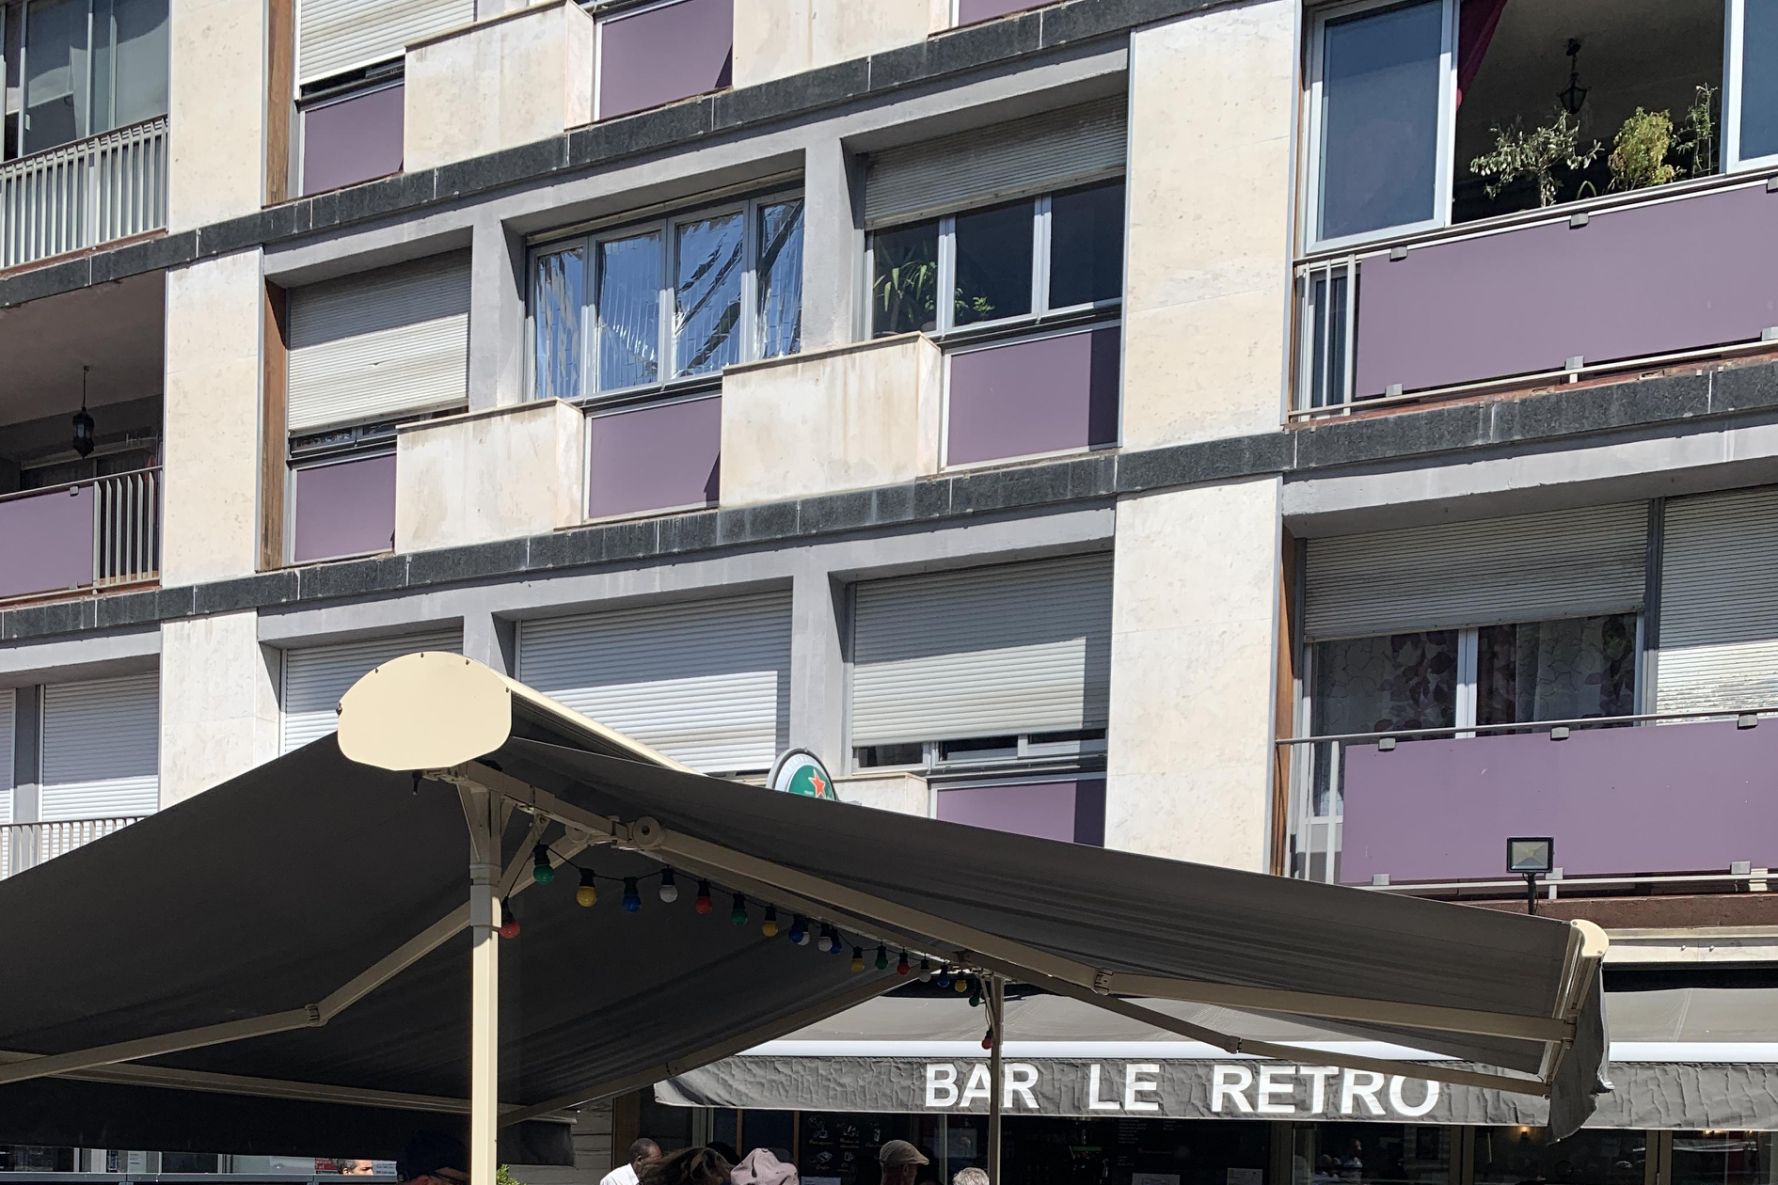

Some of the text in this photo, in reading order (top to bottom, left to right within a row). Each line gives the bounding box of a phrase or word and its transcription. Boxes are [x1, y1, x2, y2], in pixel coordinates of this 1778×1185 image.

[924, 1063, 1440, 1118] BAR LE RETRO
